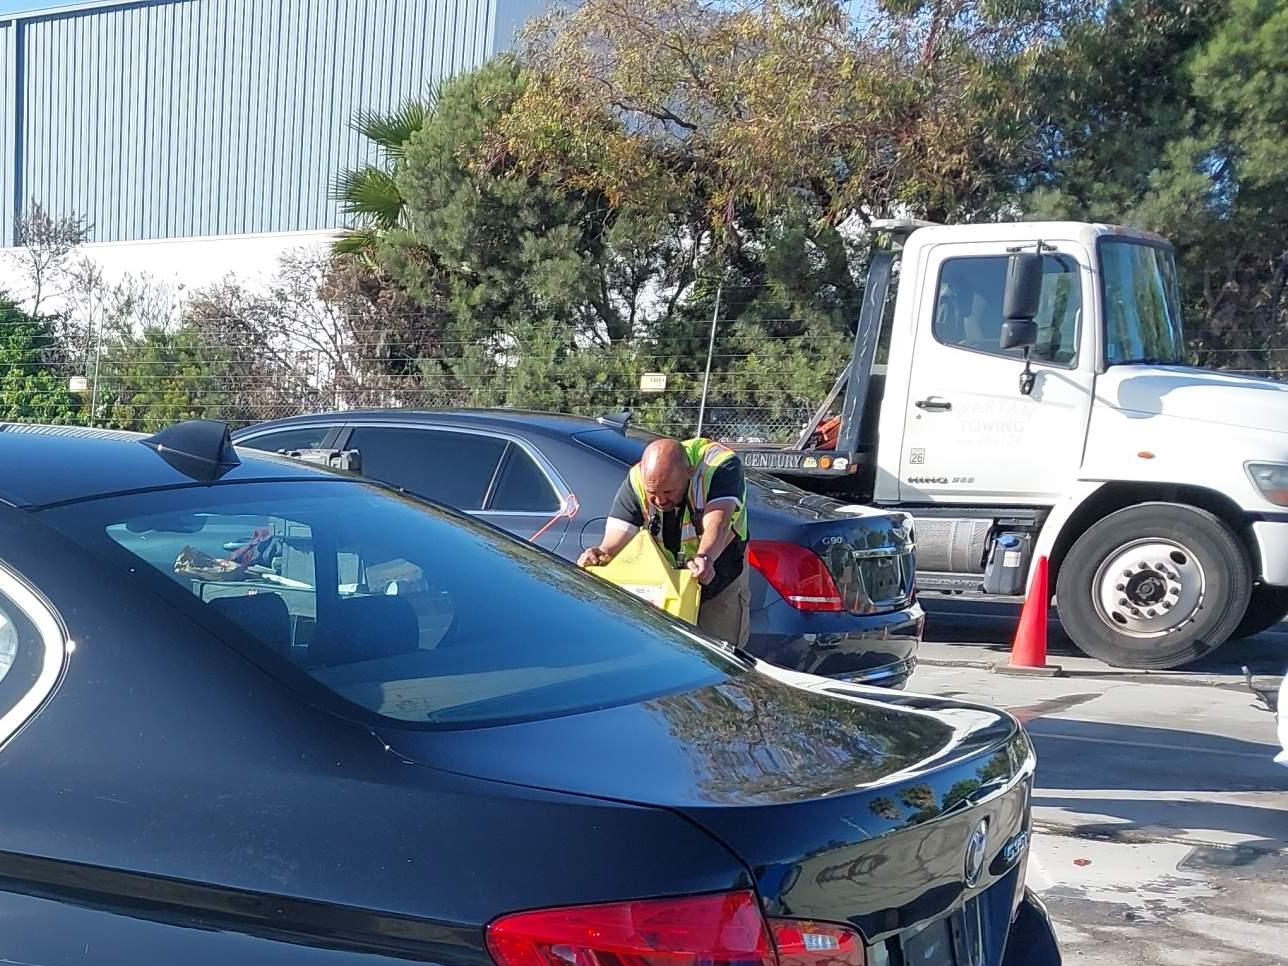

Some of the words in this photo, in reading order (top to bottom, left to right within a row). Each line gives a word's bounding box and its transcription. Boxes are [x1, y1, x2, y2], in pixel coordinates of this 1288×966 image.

[953, 401, 1033, 419] SPARTAN
[961, 419, 1025, 433] TOWING
[744, 453, 803, 467] CENTURY
[911, 452, 923, 463] 26
[907, 476, 948, 484] HINO
[822, 536, 843, 545] G90
